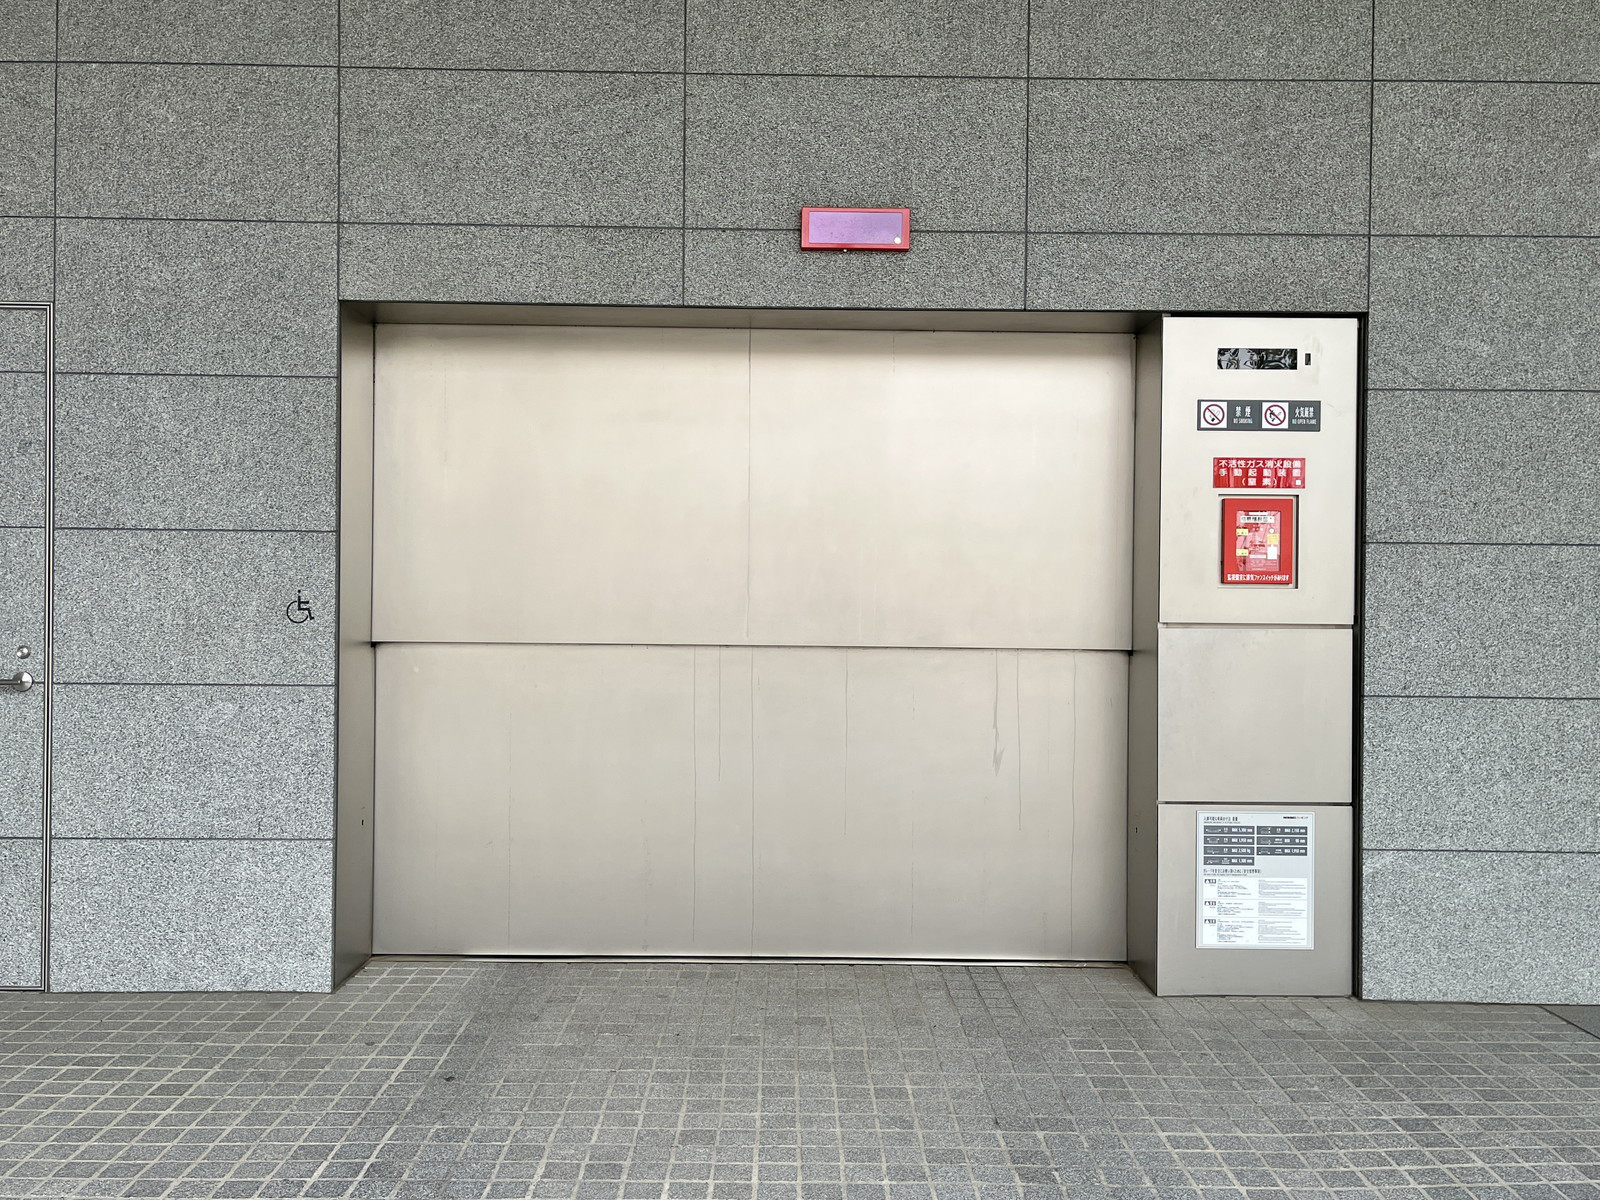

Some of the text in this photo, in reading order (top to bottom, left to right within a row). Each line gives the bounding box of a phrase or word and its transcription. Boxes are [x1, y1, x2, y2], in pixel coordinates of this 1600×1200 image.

[1235, 406, 1251, 418] 禁煙
[1218, 459, 1301, 469] 不活性ガス消火設備
[1218, 468, 1301, 477] 手動起動装置
